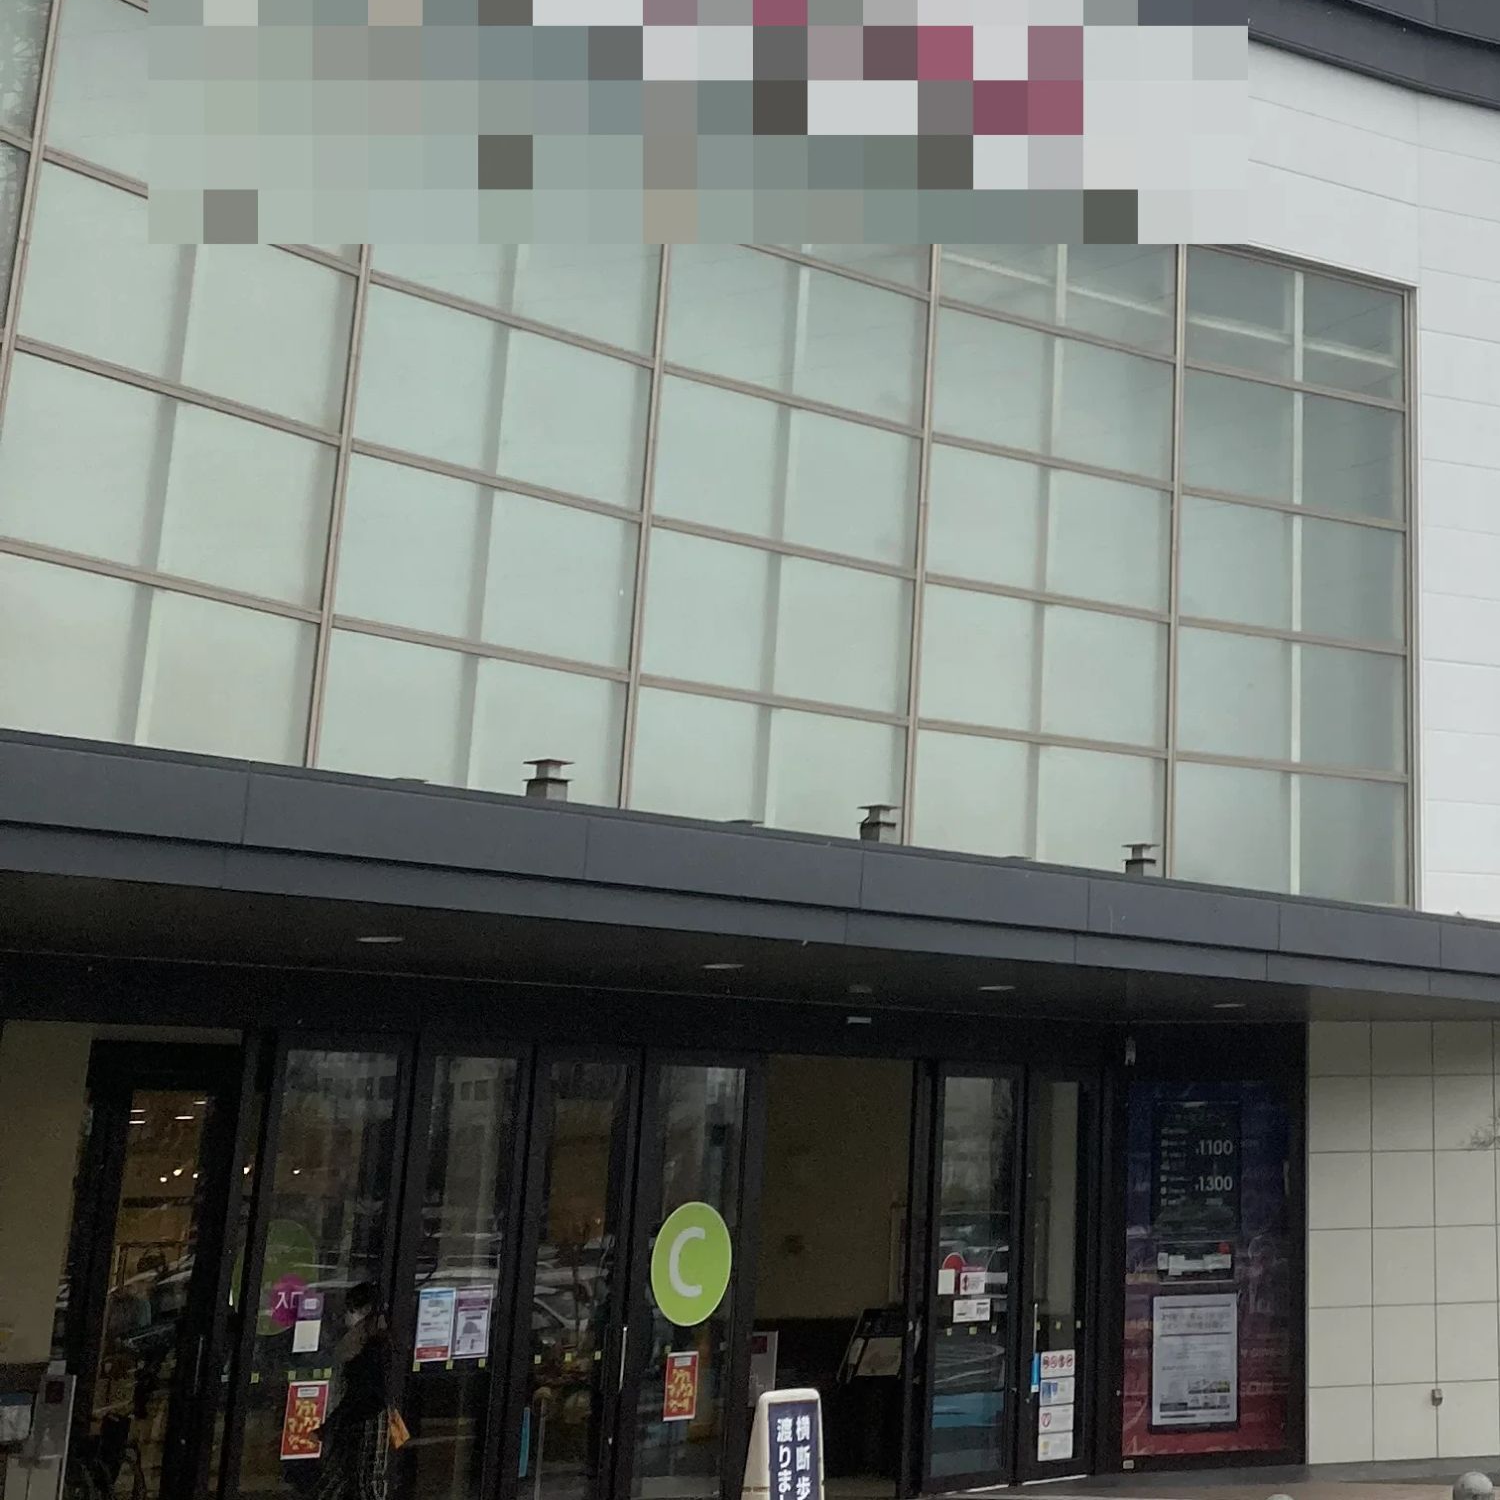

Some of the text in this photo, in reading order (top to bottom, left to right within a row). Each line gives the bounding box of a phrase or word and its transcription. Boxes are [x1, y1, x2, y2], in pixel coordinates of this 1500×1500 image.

[669, 1226, 705, 1297] C
[777, 1417, 793, 1500] 渡りま
